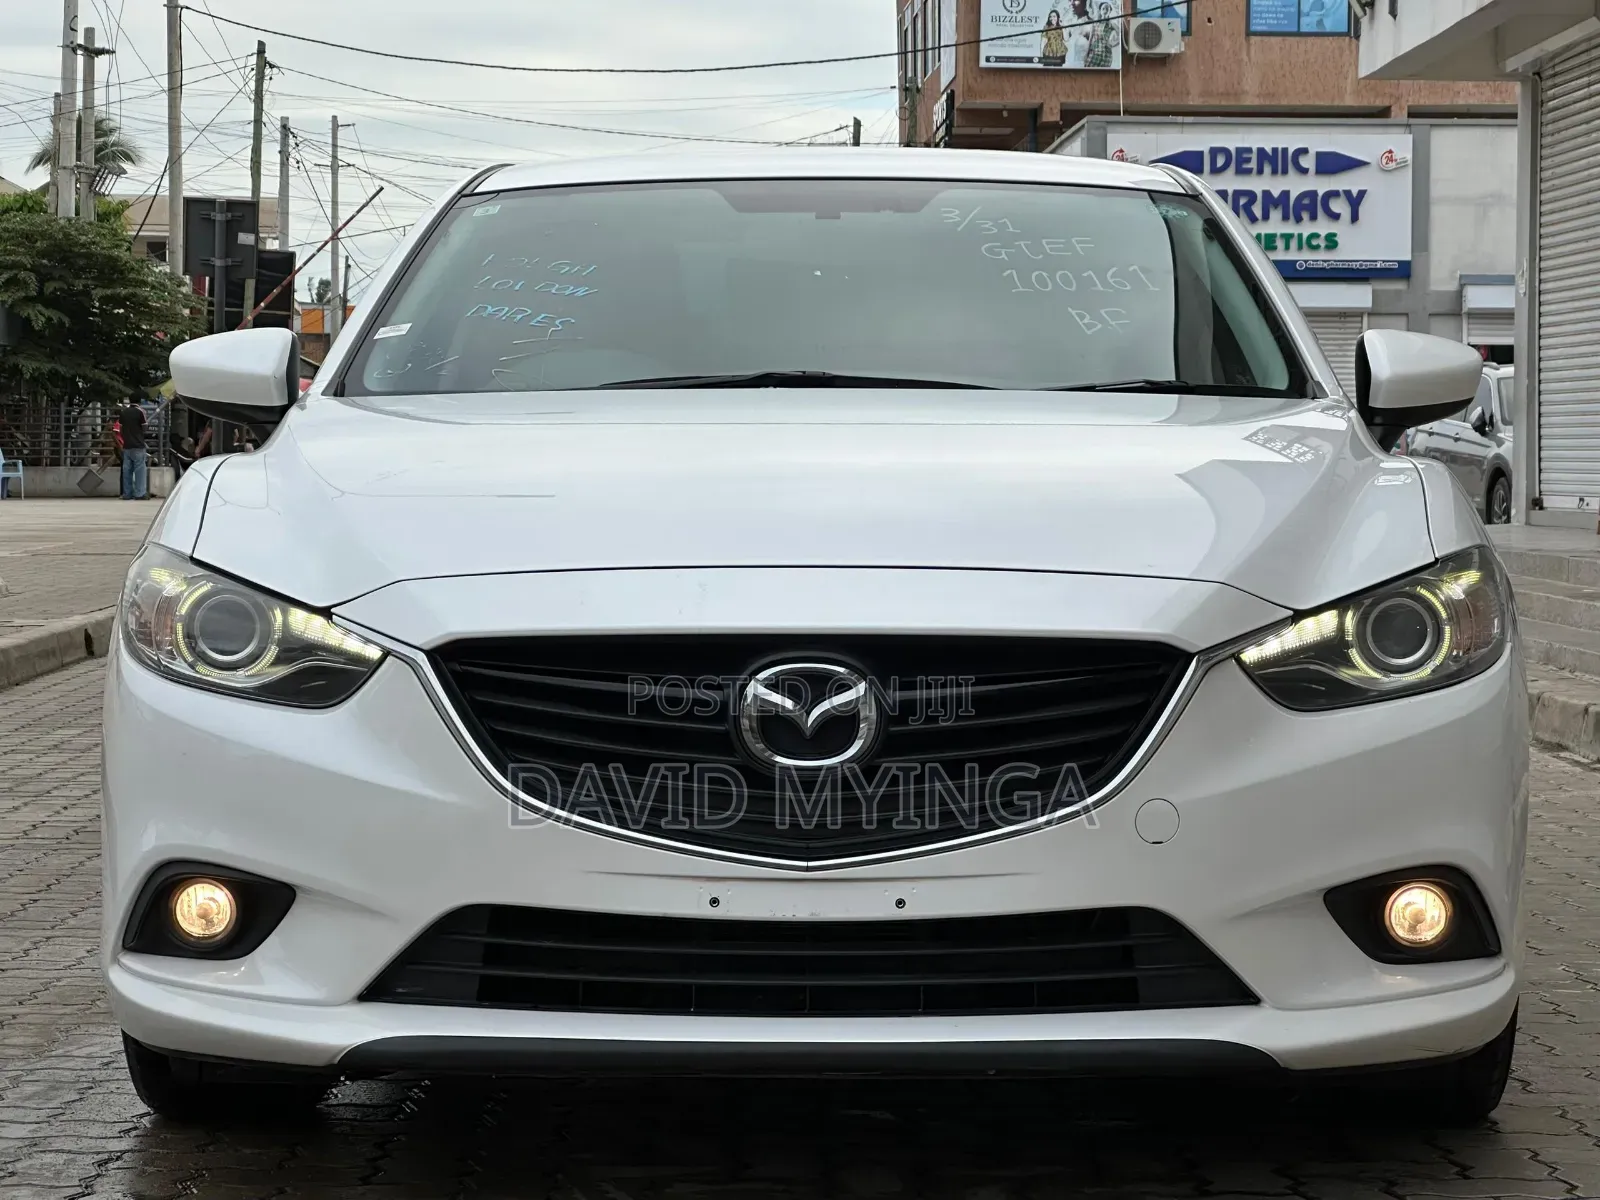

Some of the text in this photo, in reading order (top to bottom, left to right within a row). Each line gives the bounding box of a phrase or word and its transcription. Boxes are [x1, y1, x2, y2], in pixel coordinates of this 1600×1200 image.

[990, 15, 1040, 24] BIZZLEST
[1208, 146, 1310, 176] DENIC
[1215, 189, 1368, 224] RMACY
[1255, 232, 1339, 251] ETICS
[1003, 265, 1161, 292] 100161
